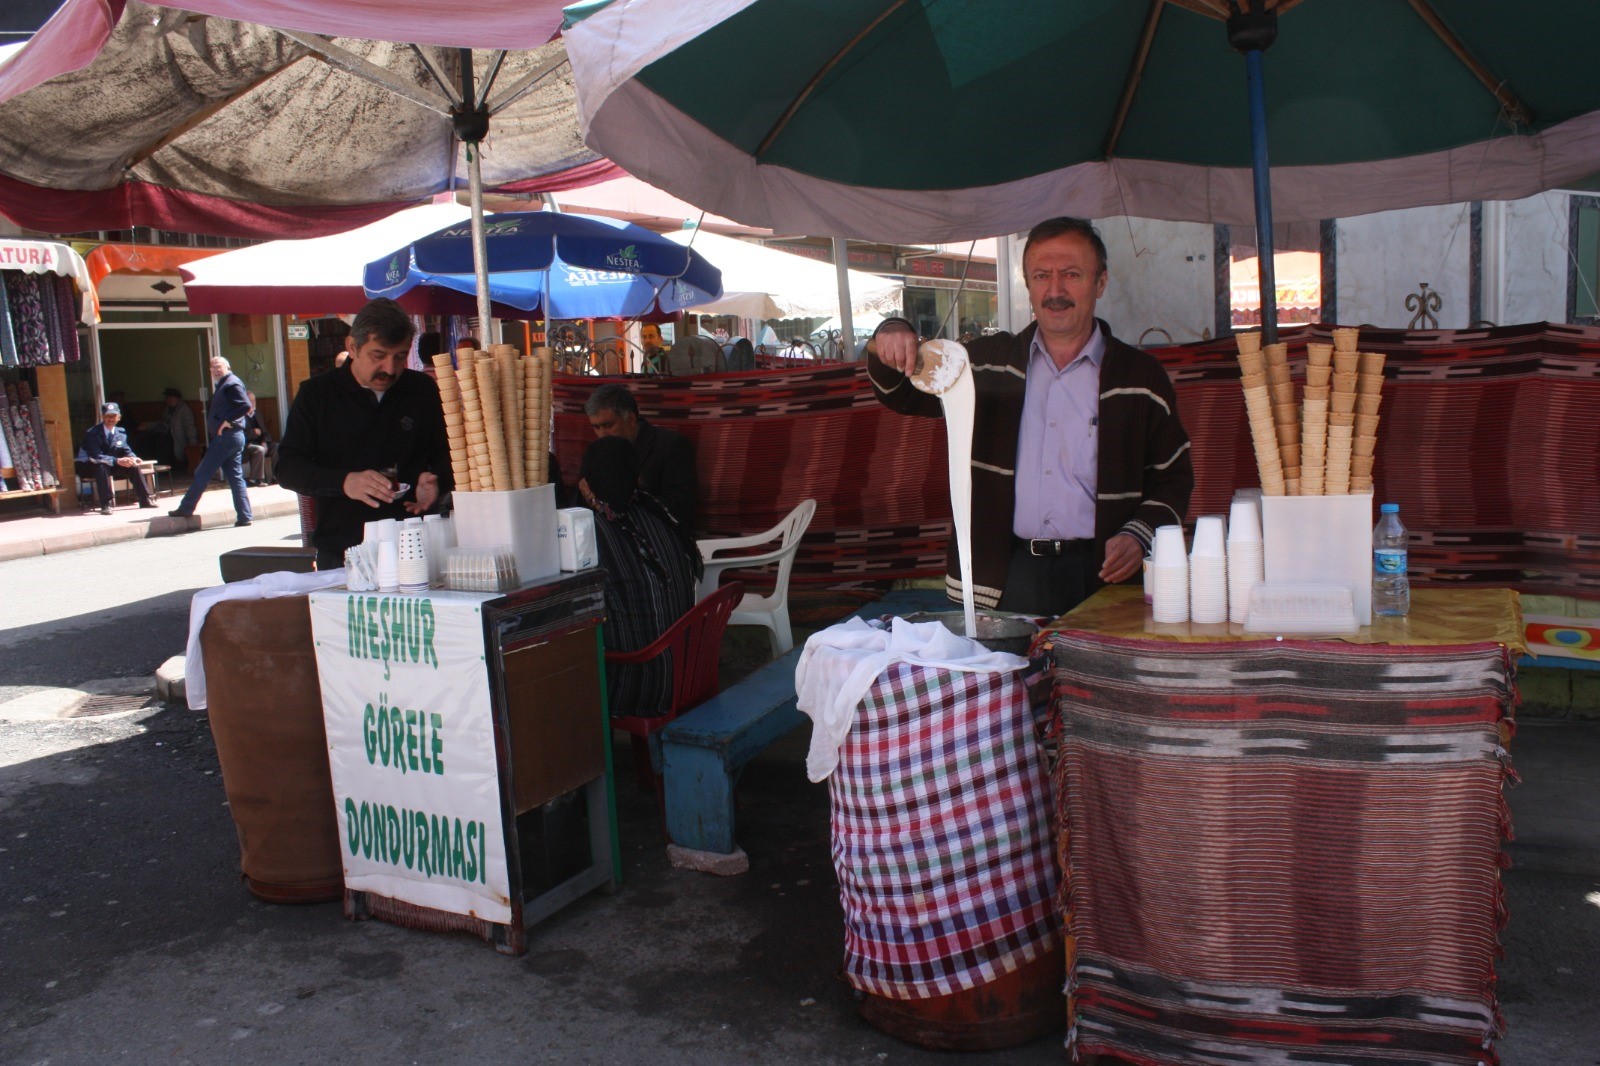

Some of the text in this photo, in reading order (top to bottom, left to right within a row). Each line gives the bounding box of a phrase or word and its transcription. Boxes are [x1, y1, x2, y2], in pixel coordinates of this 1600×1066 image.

[606, 255, 639, 268] NESTEA
[913, 260, 944, 276] BILGE
[348, 595, 438, 681] MEŞHUR
[363, 692, 444, 775] GÖRELE
[345, 797, 486, 884] DONDURMASI
